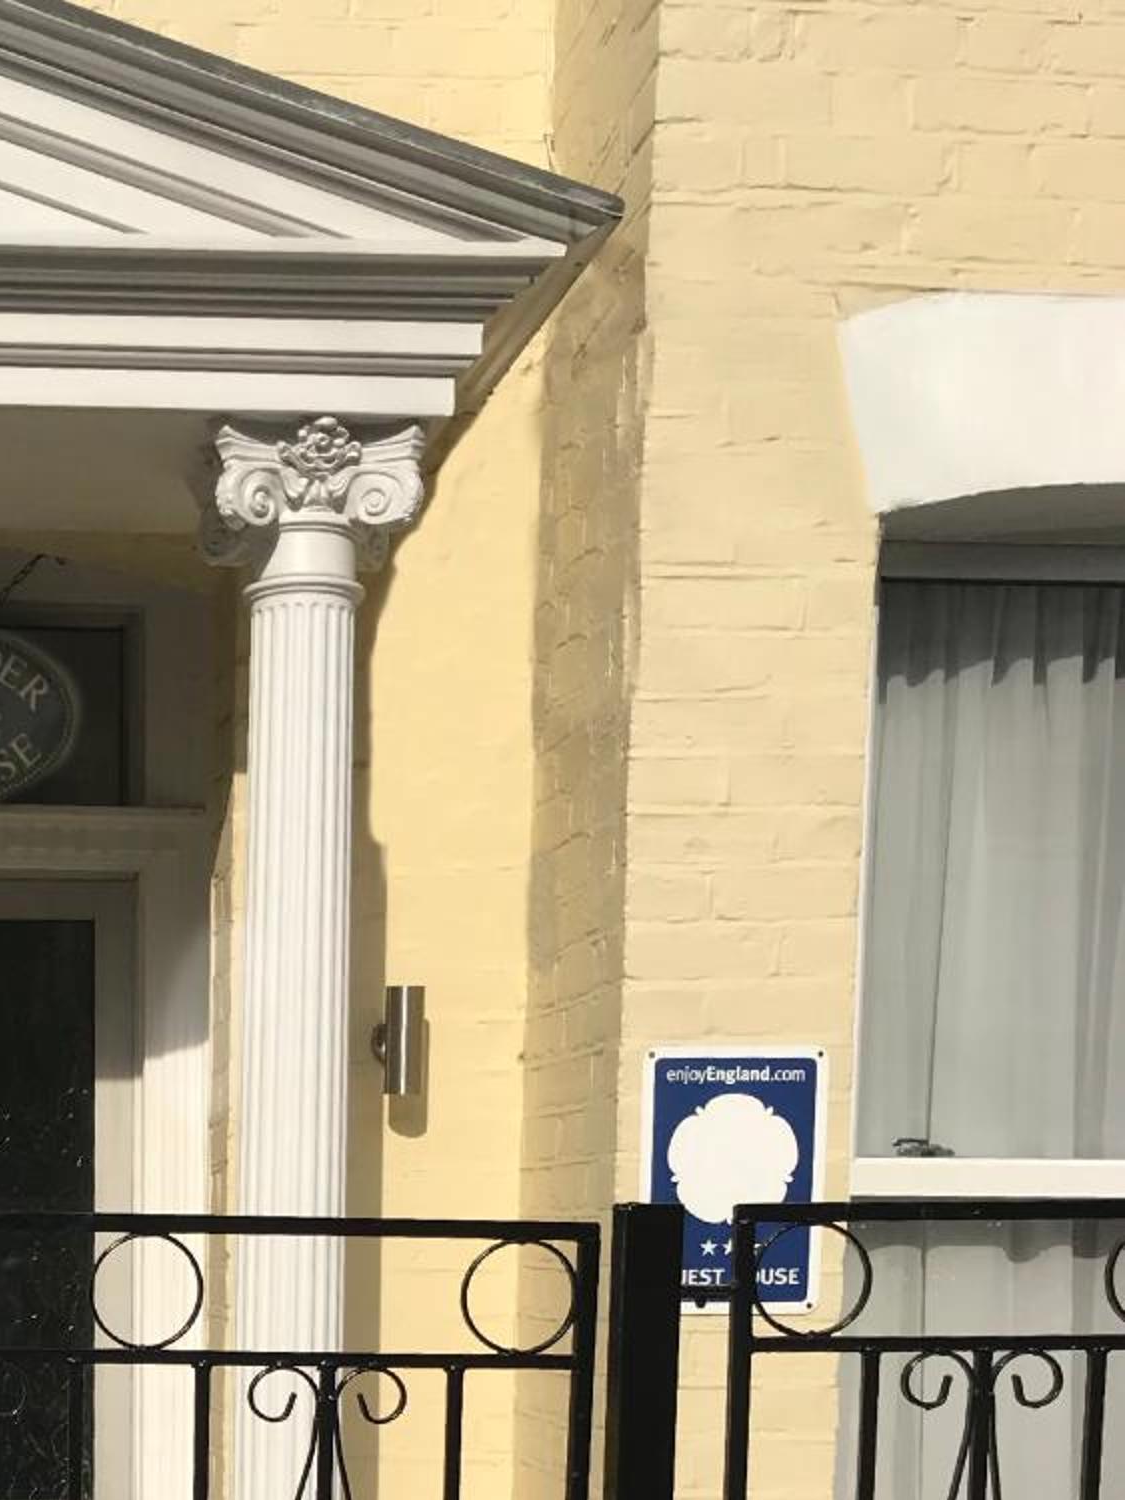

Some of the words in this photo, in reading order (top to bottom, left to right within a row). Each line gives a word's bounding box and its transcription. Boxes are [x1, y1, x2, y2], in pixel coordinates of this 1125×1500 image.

[666, 1065, 806, 1084] enjoyEngland.com
[681, 1268, 725, 1286] EST
[756, 1267, 800, 1285] USE
